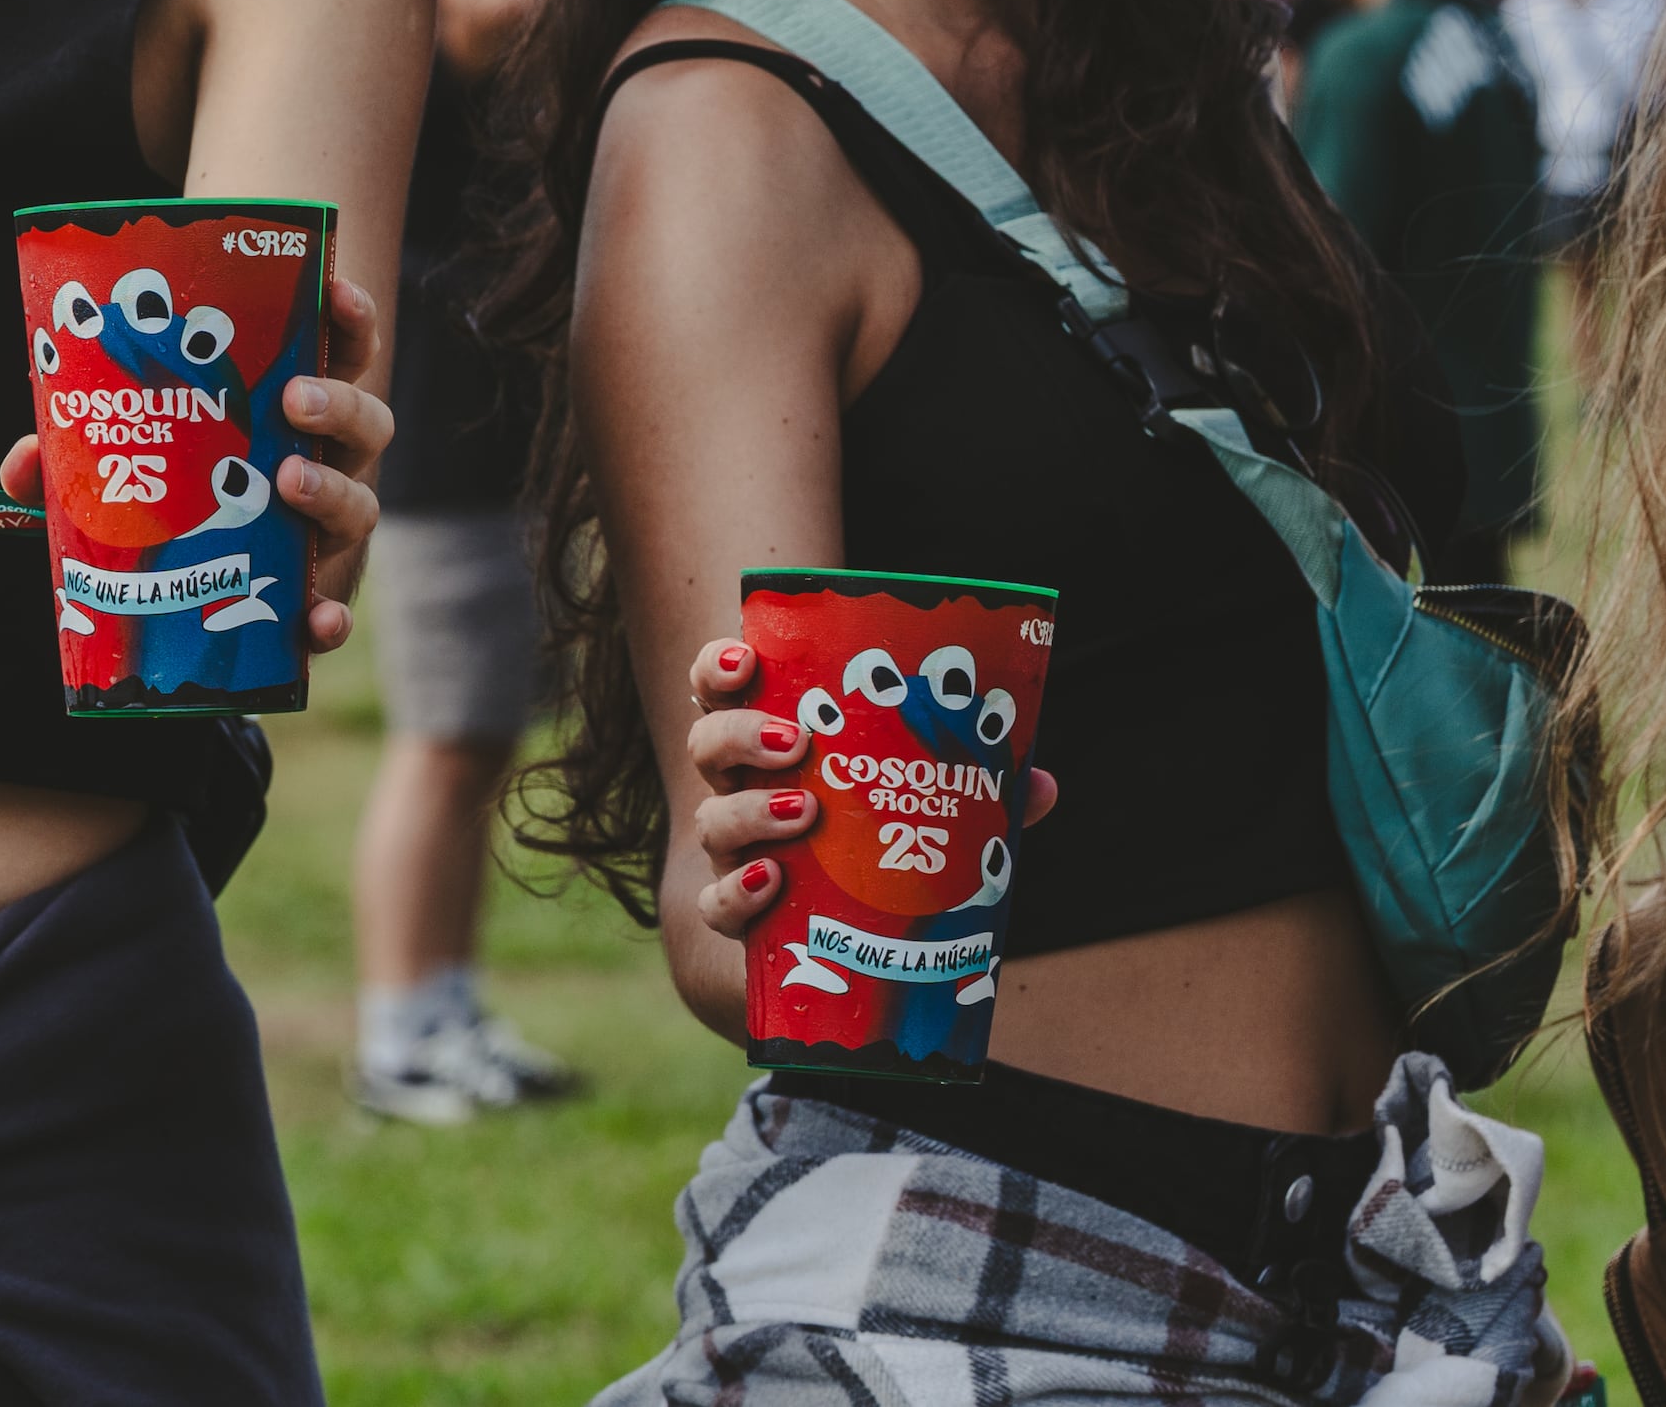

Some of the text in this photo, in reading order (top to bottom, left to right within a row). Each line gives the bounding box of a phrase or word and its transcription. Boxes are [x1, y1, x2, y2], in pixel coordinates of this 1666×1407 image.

[222, 229, 307, 257] #CR25
[50, 388, 228, 428] COSQUIN
[85, 421, 174, 445] ROCK
[97, 453, 168, 503] 25
[67, 567, 242, 605] NOS UNE LA MÚSICA
[820, 752, 1004, 802] COSQUIN
[868, 788, 959, 817] ROCK
[878, 821, 949, 874] 25
[813, 927, 852, 954] NOS
[855, 942, 896, 970] UNE
[901, 950, 927, 973] LA
